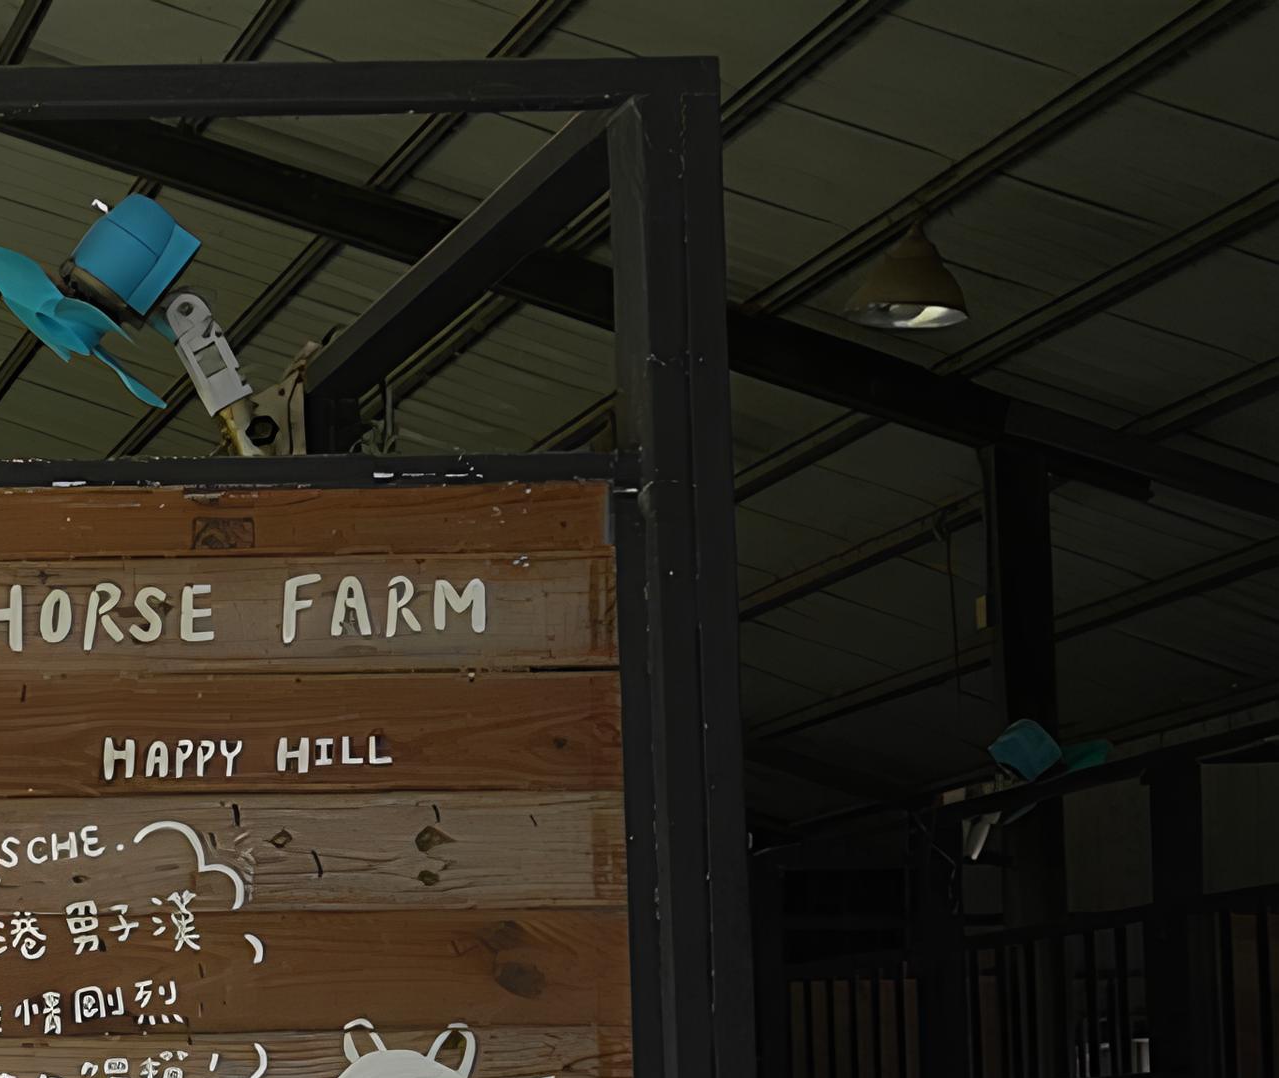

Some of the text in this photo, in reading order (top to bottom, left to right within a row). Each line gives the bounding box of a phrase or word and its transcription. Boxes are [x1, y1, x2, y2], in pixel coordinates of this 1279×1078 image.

[282, 573, 487, 644] FARM
[103, 735, 393, 780] HAPPY HILL
